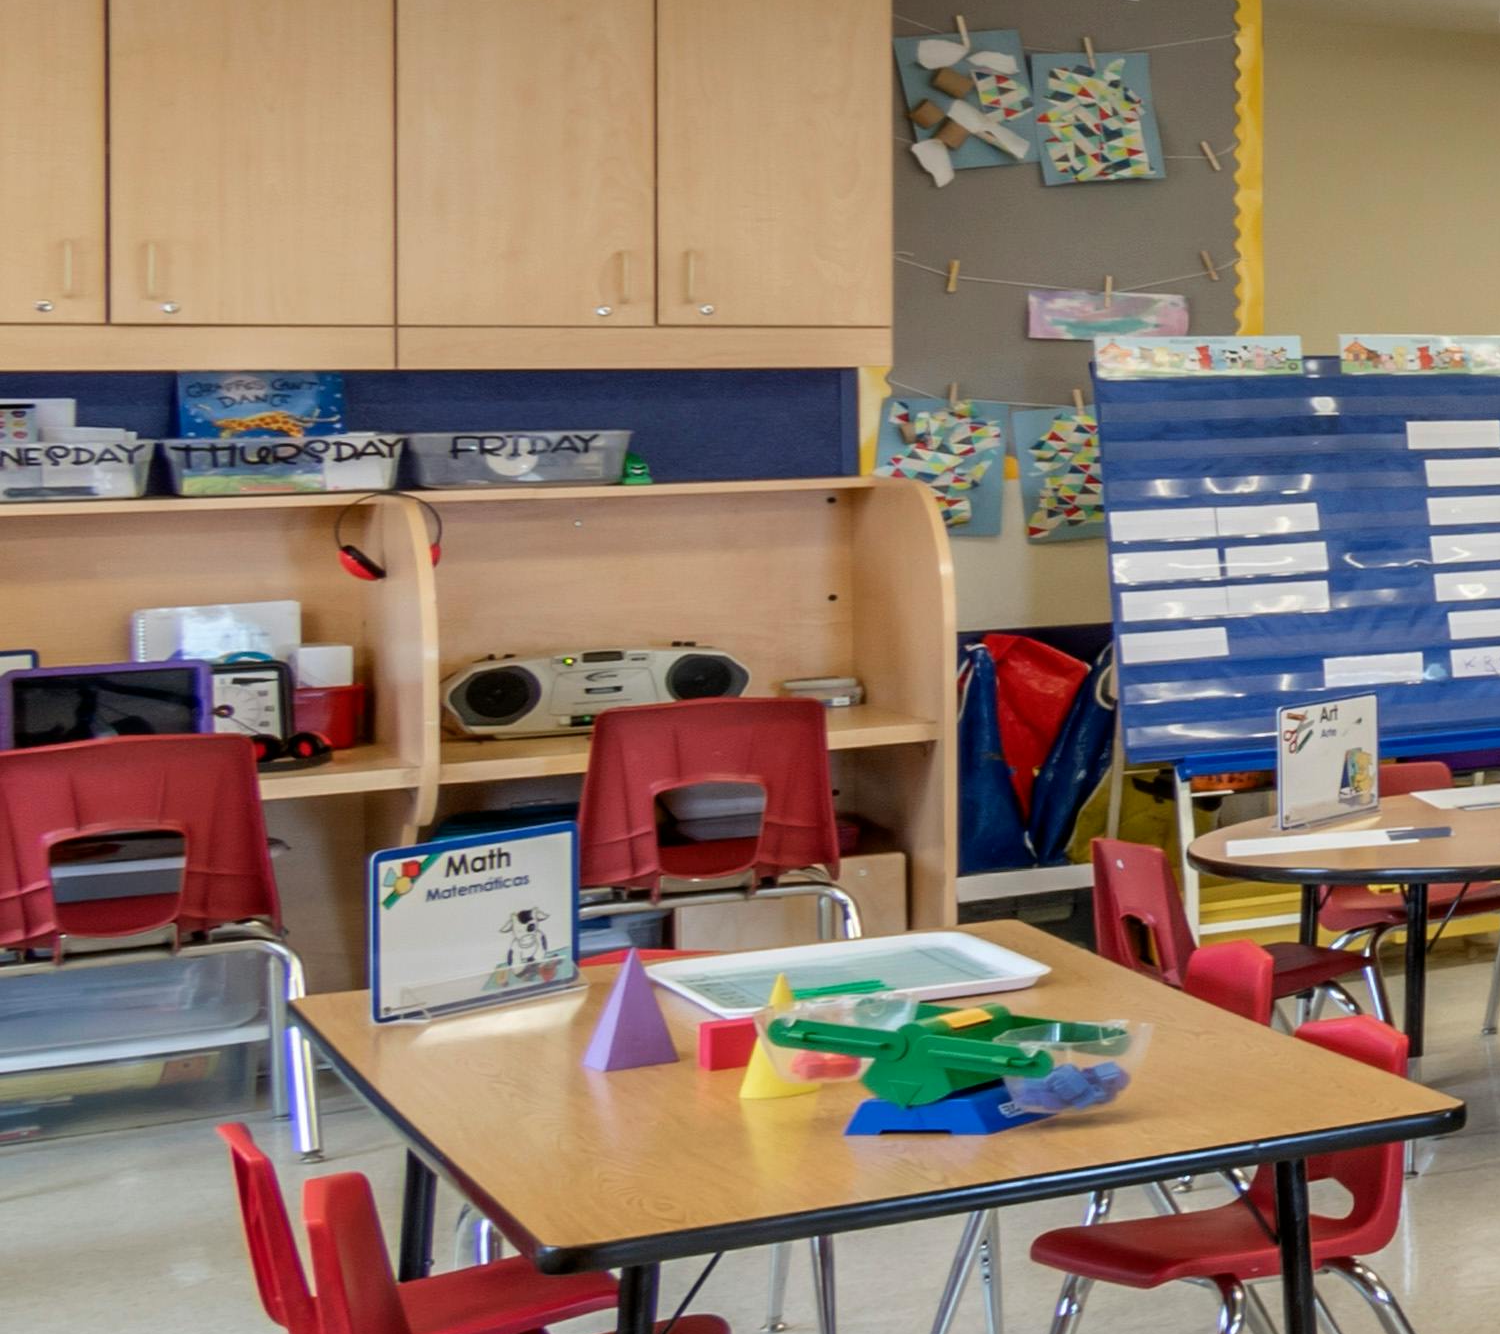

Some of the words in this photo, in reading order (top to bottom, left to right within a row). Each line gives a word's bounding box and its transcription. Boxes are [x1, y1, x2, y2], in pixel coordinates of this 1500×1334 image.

[170, 437, 407, 469] THURSDAY
[449, 433, 603, 462] FRIDAY
[1320, 706, 1339, 723] Art
[445, 848, 511, 878] Math
[425, 873, 530, 902] Matemáticas
